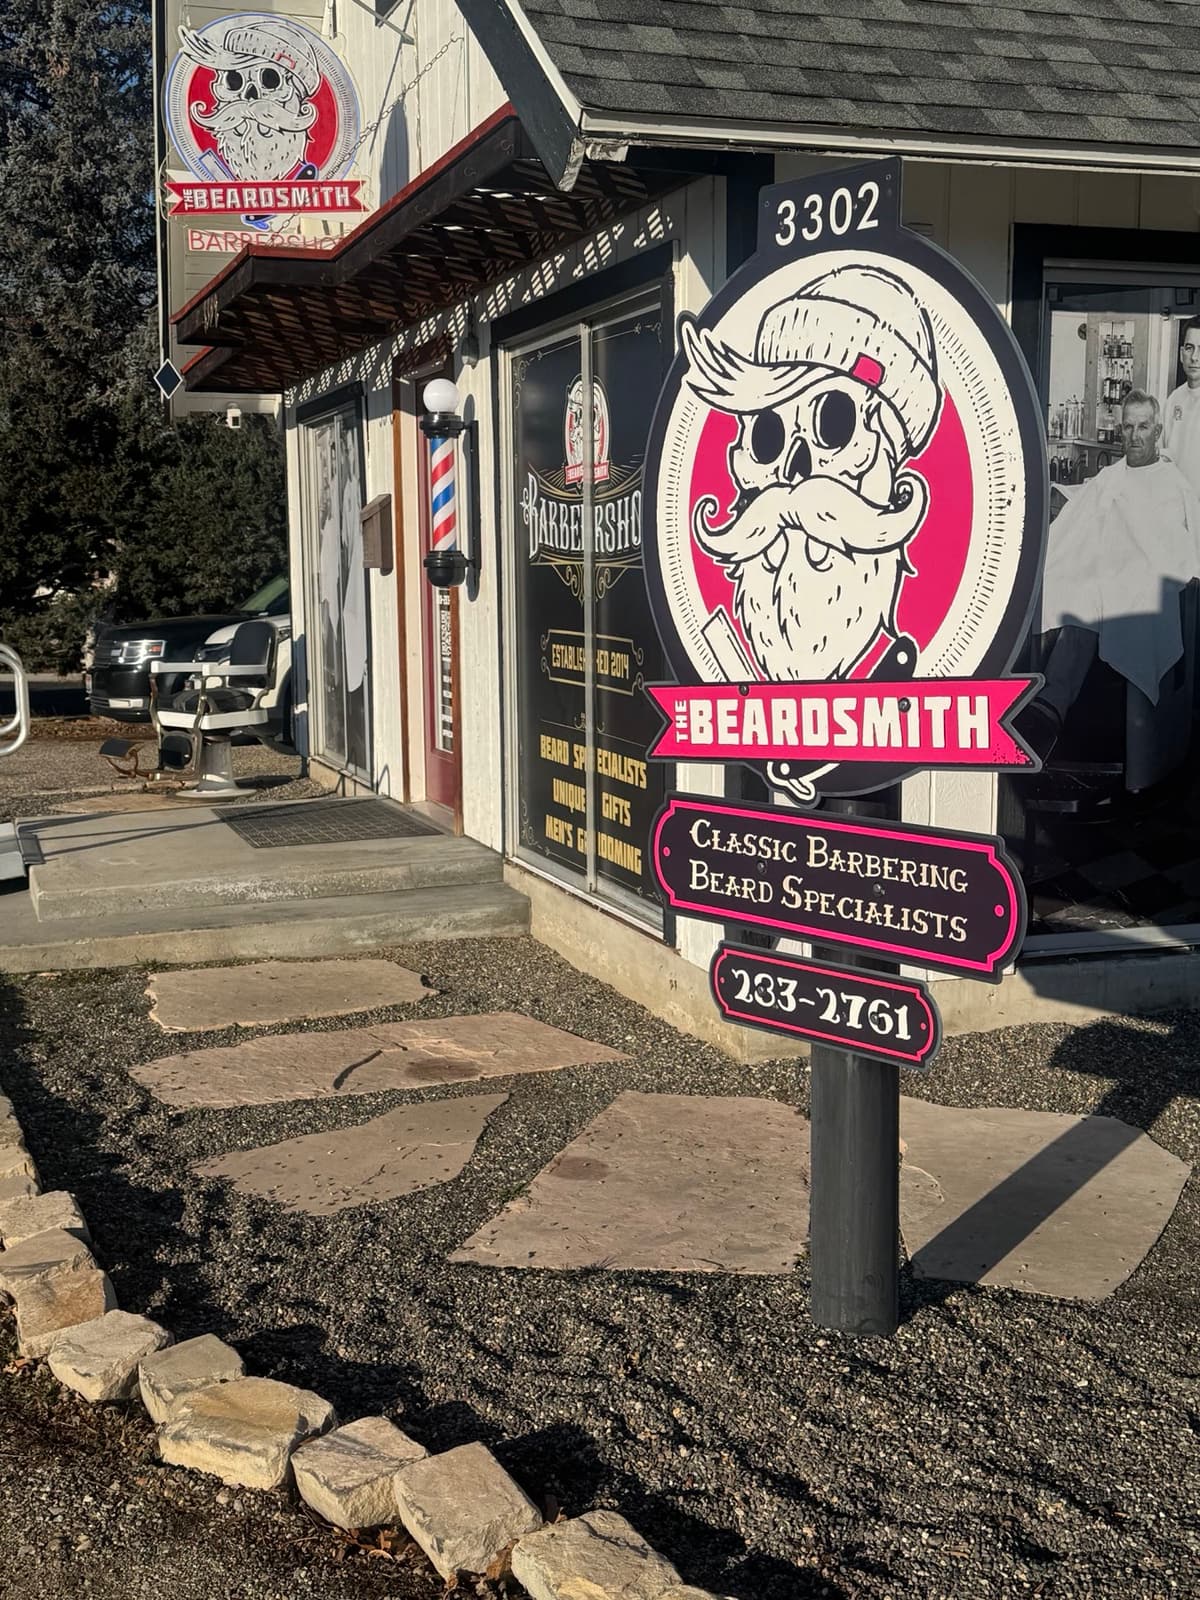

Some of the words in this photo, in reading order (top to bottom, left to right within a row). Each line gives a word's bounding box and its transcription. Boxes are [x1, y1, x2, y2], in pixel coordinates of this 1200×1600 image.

[183, 189, 194, 211] THE
[193, 186, 350, 210] BEARDSMITH
[775, 181, 880, 246] 3302
[189, 229, 346, 252] BARBERSHO
[520, 472, 642, 559] BARBERSHO
[611, 651, 630, 680] 2014
[675, 700, 690, 743] THE
[690, 695, 990, 749] BEARDSMITH
[540, 734, 569, 767] BEARD
[553, 777, 586, 814] UNIQUE
[602, 791, 631, 828] GIFTS
[545, 814, 573, 849] MEN'S
[689, 818, 797, 863] CLASSIC
[806, 834, 969, 893] BARBERING
[688, 858, 774, 903] BEARD
[781, 875, 968, 942] SPECIALISTS
